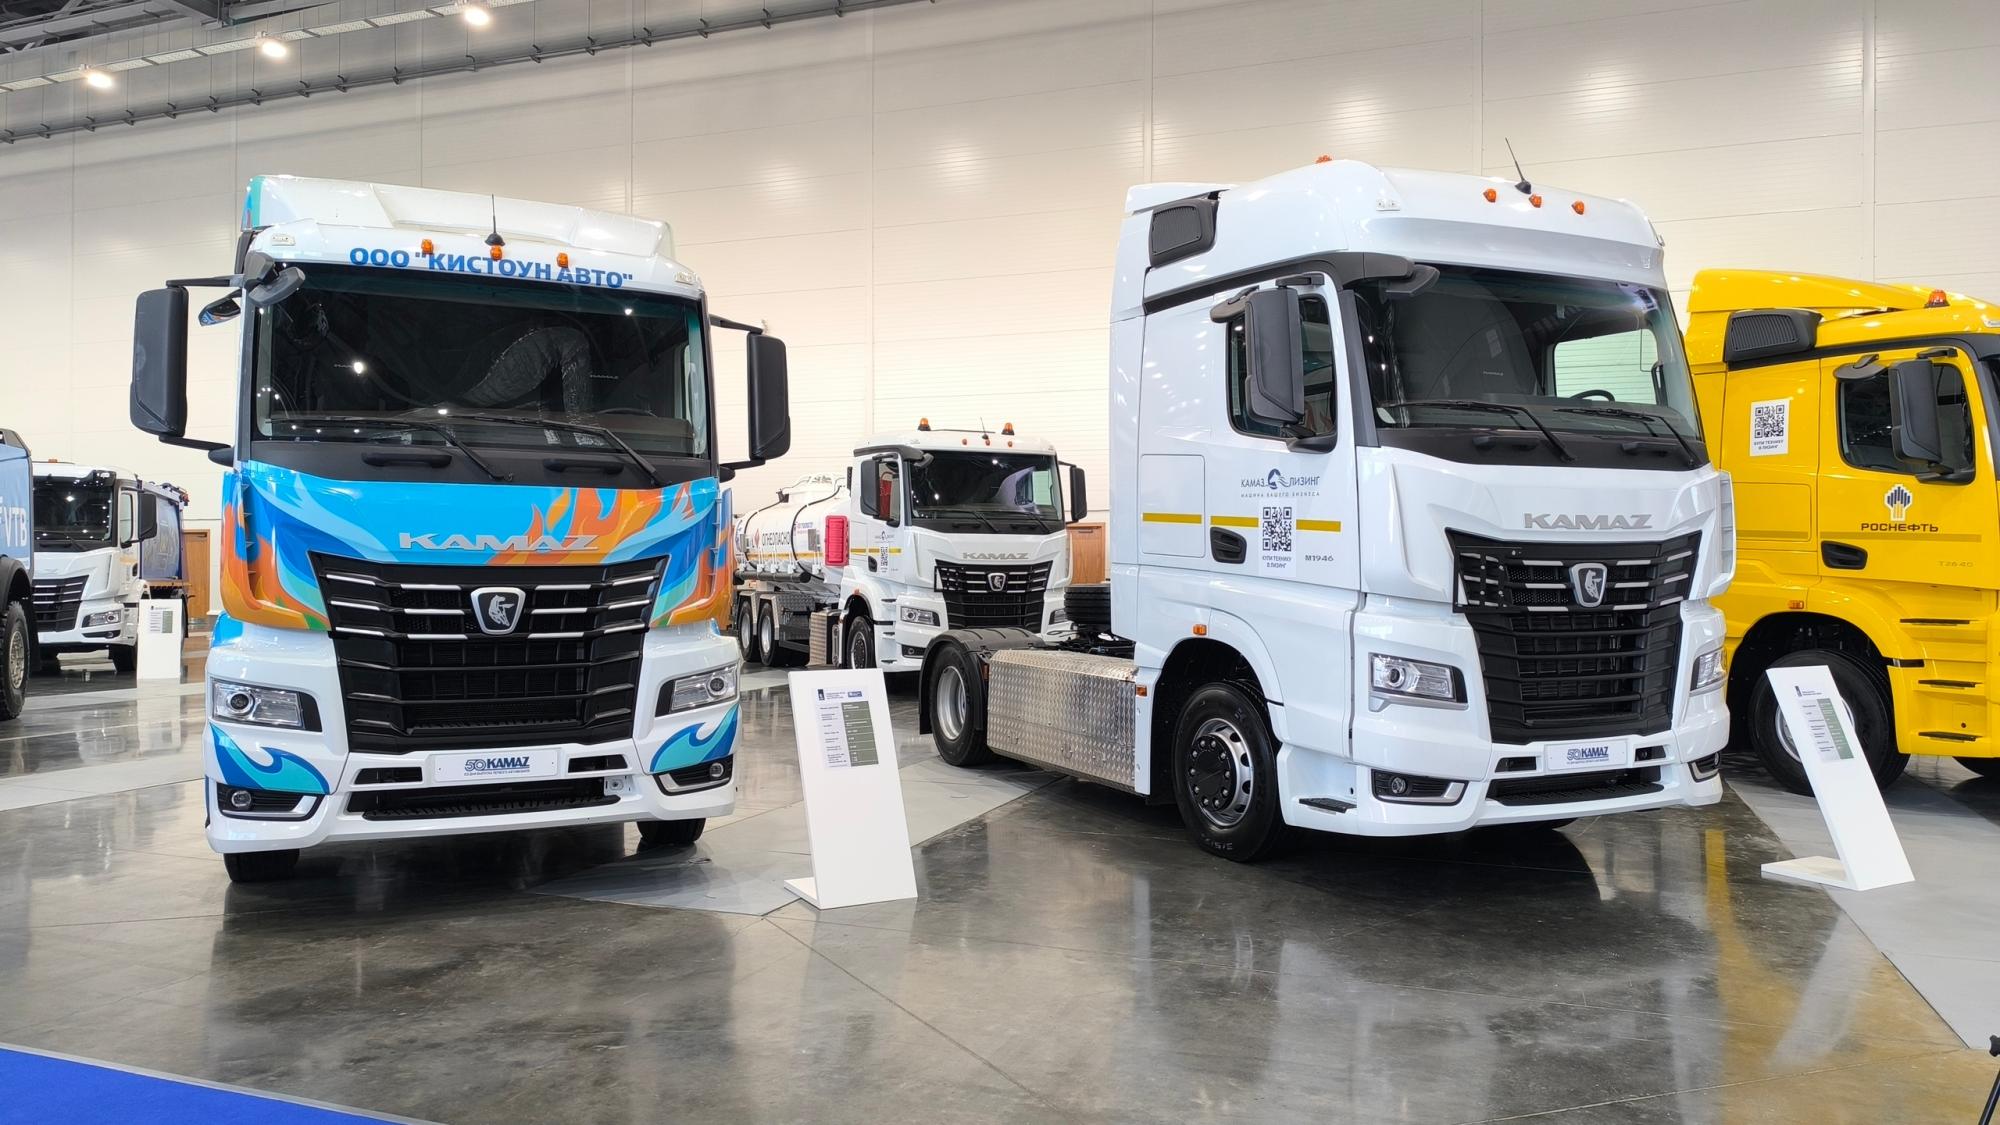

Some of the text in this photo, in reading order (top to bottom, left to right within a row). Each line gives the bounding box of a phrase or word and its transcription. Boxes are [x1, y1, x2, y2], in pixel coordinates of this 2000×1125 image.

[350, 247, 410, 268] ООО
[556, 266, 633, 289] АВТО"
[1241, 476, 1320, 488] КАМАЗ ЛИЗИНГ
[3, 506, 28, 548] VTB
[1523, 513, 1652, 530] KAMAZ
[1861, 523, 1939, 532] РОСНЕФТЬ
[398, 532, 599, 551] KAMAZ
[962, 552, 1029, 560] KAMAZ
[1305, 554, 1334, 562] M1946
[1581, 746, 1609, 757] KAMAZ
[464, 756, 530, 772] 50 KAMAZ
